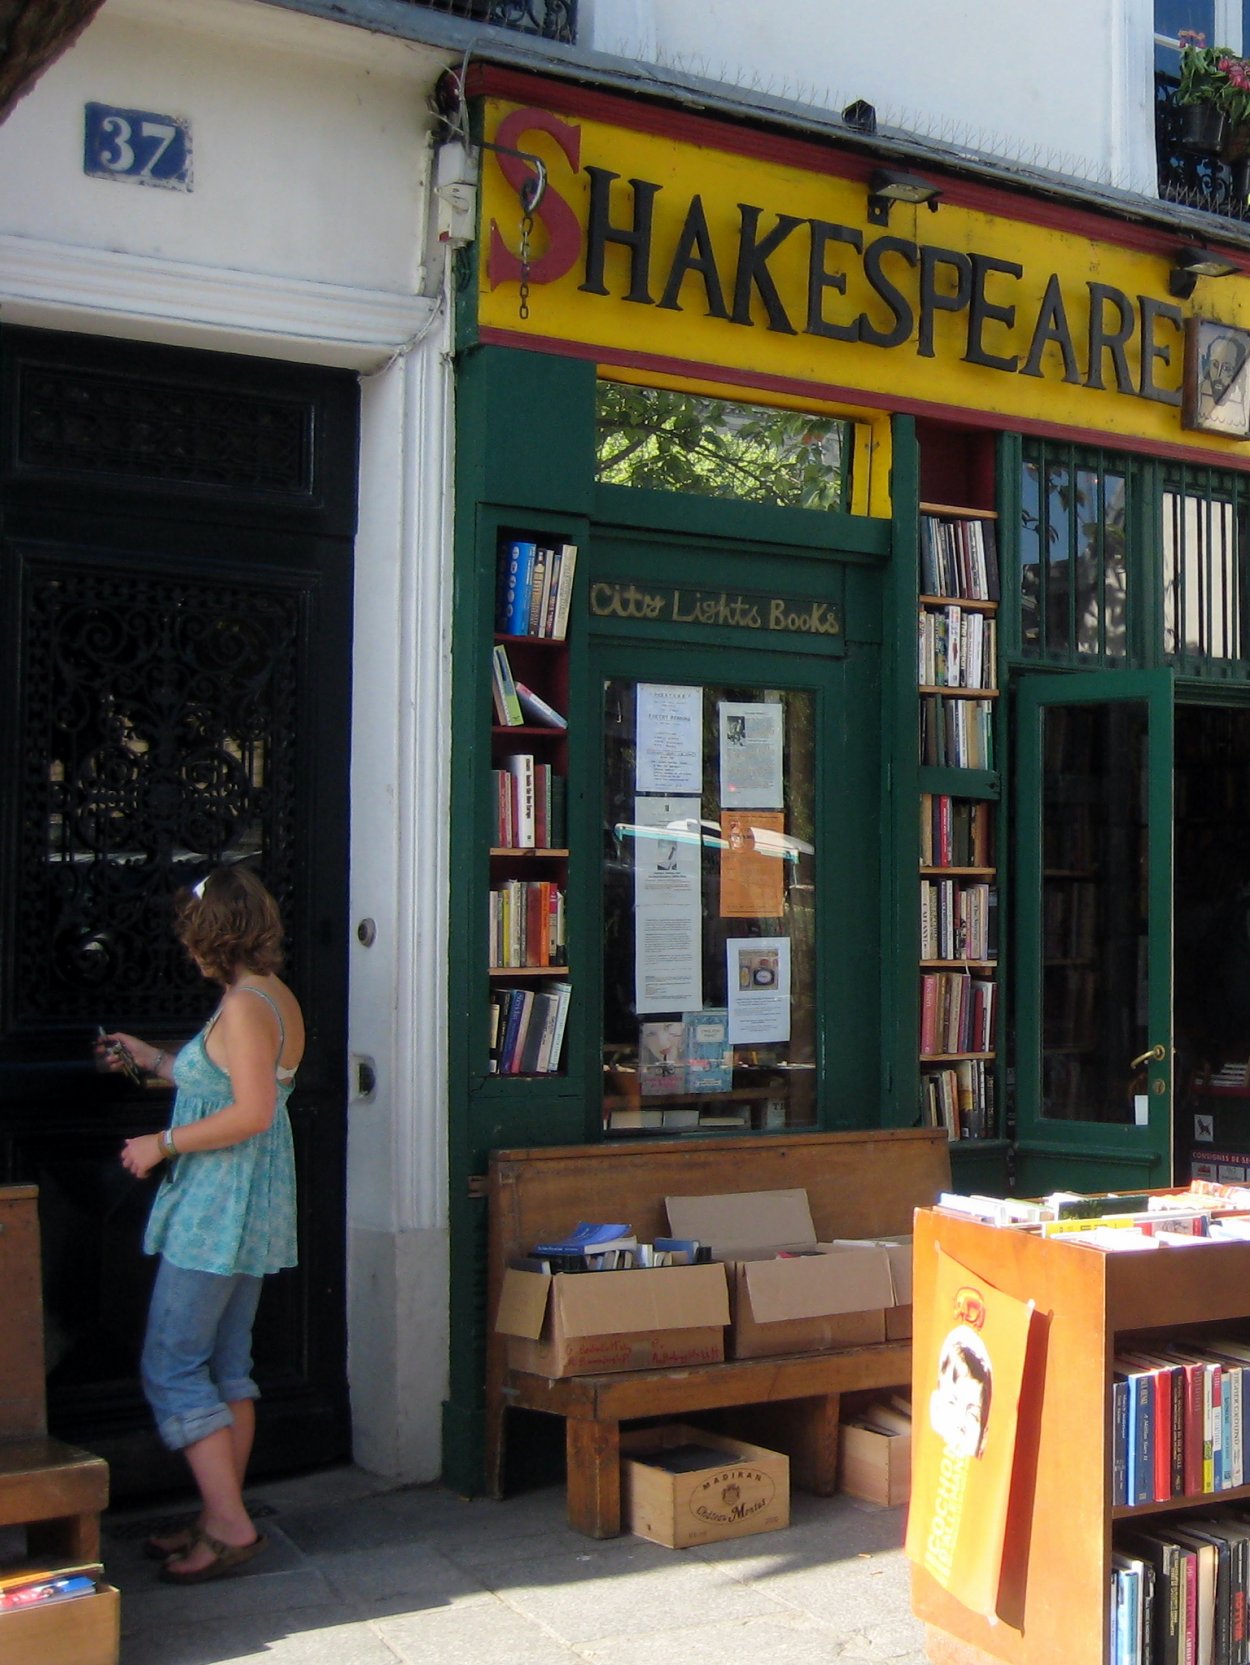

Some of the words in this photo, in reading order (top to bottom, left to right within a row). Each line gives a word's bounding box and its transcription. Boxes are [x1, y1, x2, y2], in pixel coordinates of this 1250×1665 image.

[100, 116, 176, 177] 37
[489, 107, 1186, 407] SHAKESPEARE
[590, 582, 665, 617] City
[671, 589, 762, 629] Lights
[702, 1471, 762, 1490] MADIRAN
[727, 1498, 766, 1523] Montus
